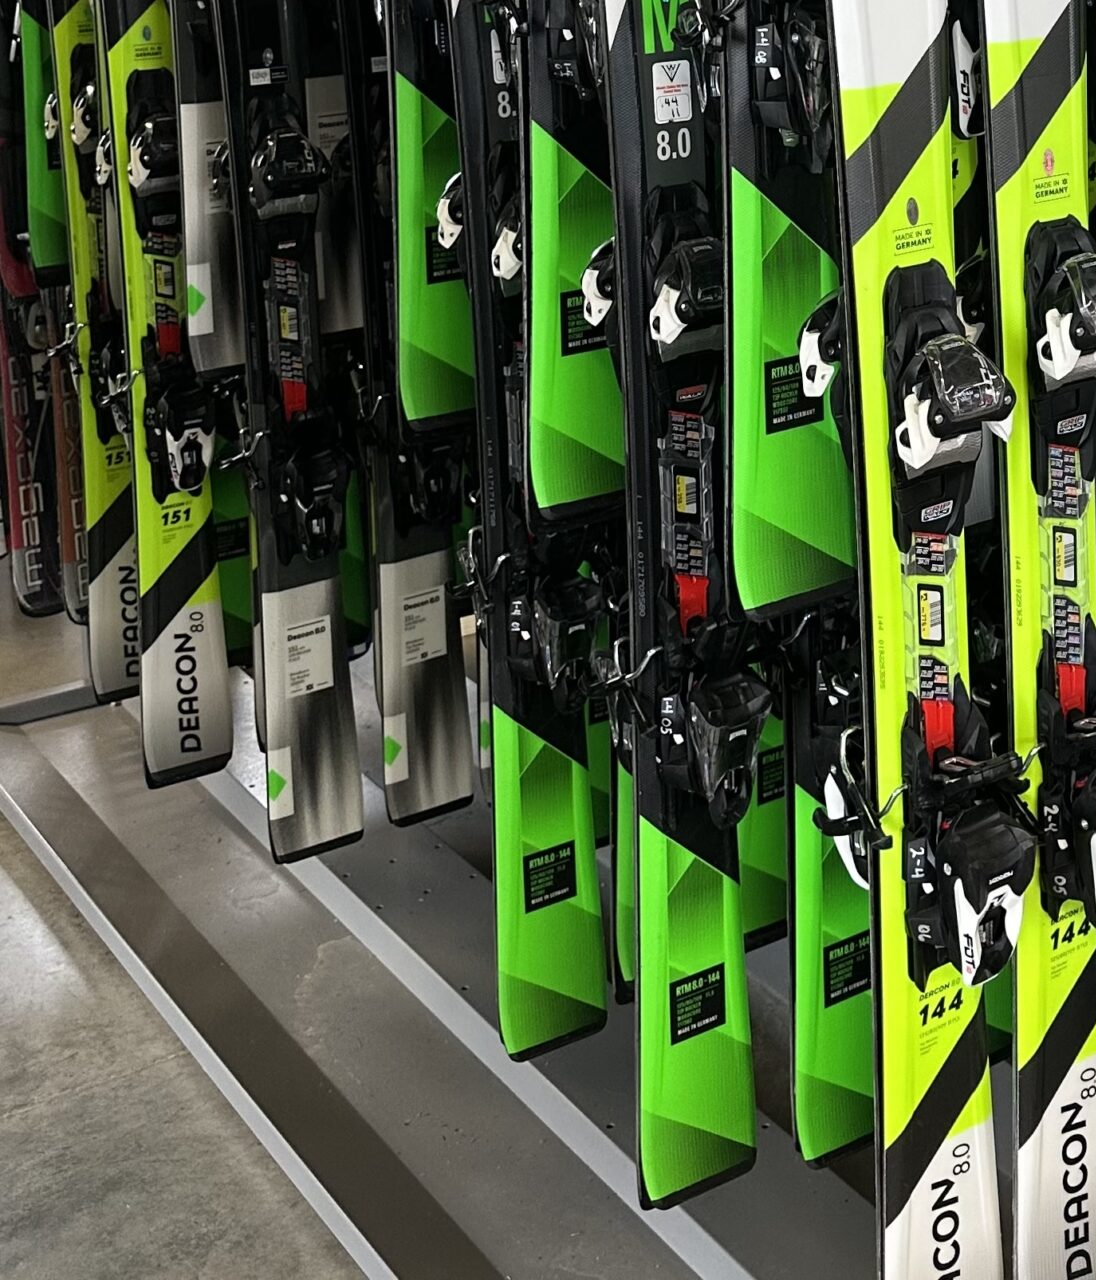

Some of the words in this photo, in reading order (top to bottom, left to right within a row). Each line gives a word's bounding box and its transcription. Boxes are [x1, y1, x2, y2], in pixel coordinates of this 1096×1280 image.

[960, 69, 972, 109] FDT
[656, 127, 691, 161] 8.0
[1034, 181, 1052, 190] MADE
[1053, 179, 1061, 187] IN
[1035, 186, 1069, 199] GERMANY
[895, 231, 914, 241] MADE
[915, 229, 924, 238] IN
[895, 237, 933, 250] GERMANY
[566, 296, 583, 308] RTM
[771, 366, 787, 379] RTM
[788, 363, 800, 375] 8.0
[161, 508, 191, 526] 151
[174, 633, 203, 754] DEACON
[190, 611, 204, 634] 8.0
[661, 697, 674, 714] 1-4
[660, 717, 673, 735] 05
[529, 856, 544, 870] RTM
[544, 852, 556, 866] 8.0
[559, 846, 571, 858] 144
[1044, 804, 1060, 833] 2-4
[1053, 875, 1068, 896] 05
[909, 846, 925, 879] 2-4
[917, 924, 932, 942] 06
[1051, 920, 1091, 951] 144
[829, 948, 844, 961] RTM
[845, 943, 856, 956] 8.0
[963, 933, 976, 969] FDT
[675, 982, 690, 996] RTM
[691, 977, 703, 991] 8.0
[708, 970, 720, 984] 144
[919, 988, 963, 1027] 144
[952, 1142, 971, 1176] 8.0
[1060, 1102, 1093, 1280] DEACON
